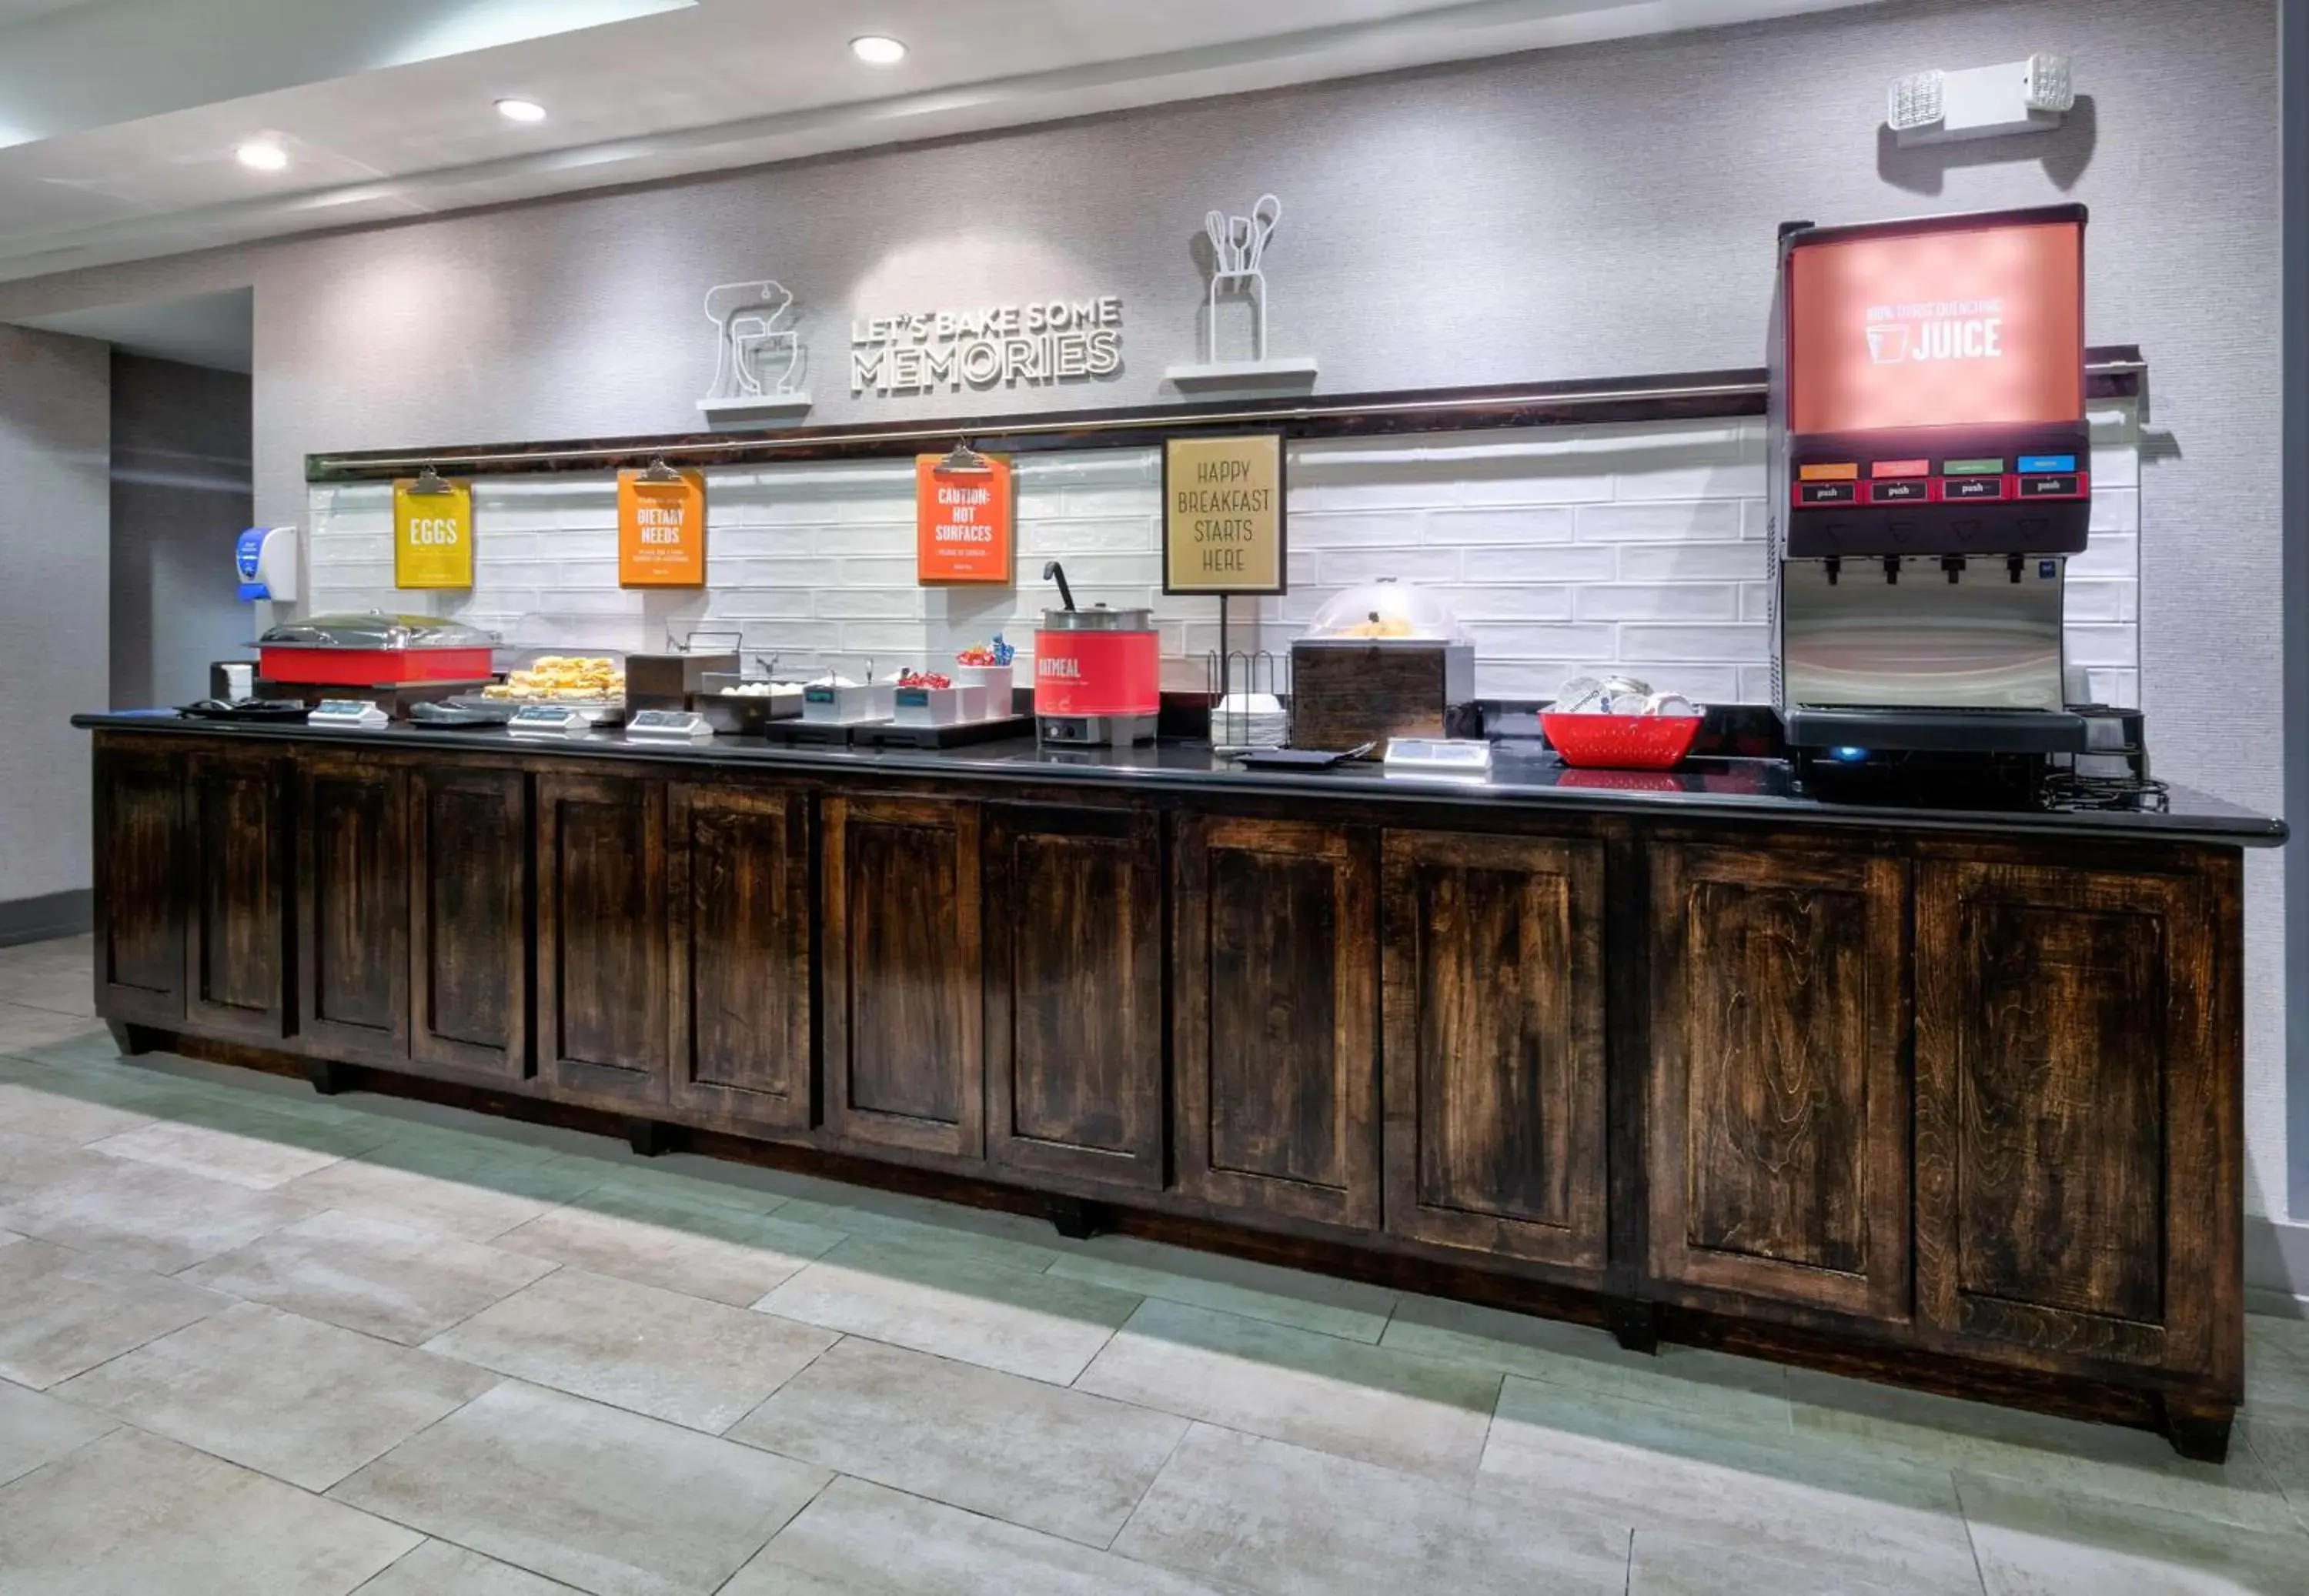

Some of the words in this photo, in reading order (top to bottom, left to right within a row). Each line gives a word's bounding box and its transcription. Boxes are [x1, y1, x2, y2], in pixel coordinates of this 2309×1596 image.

[851, 312, 928, 343] LET'S
[936, 306, 1020, 336] BAKE
[1028, 295, 1119, 329] SOME
[1912, 318, 2003, 361] JUICE
[851, 329, 1121, 391] MEMORIES
[1198, 460, 1251, 483] HAPPY
[937, 487, 991, 505] CAUTION:
[1888, 486, 1910, 497] push
[1962, 482, 1983, 495] push
[2037, 480, 2060, 492] push
[1178, 489, 1270, 513] BREAKFAST
[952, 506, 975, 523] HOT
[410, 518, 458, 545] EGGS
[641, 526, 680, 543] NEEDS
[935, 524, 992, 543] SURFACES
[1194, 519, 1254, 543] STARTS
[1203, 549, 1246, 572] HERE
